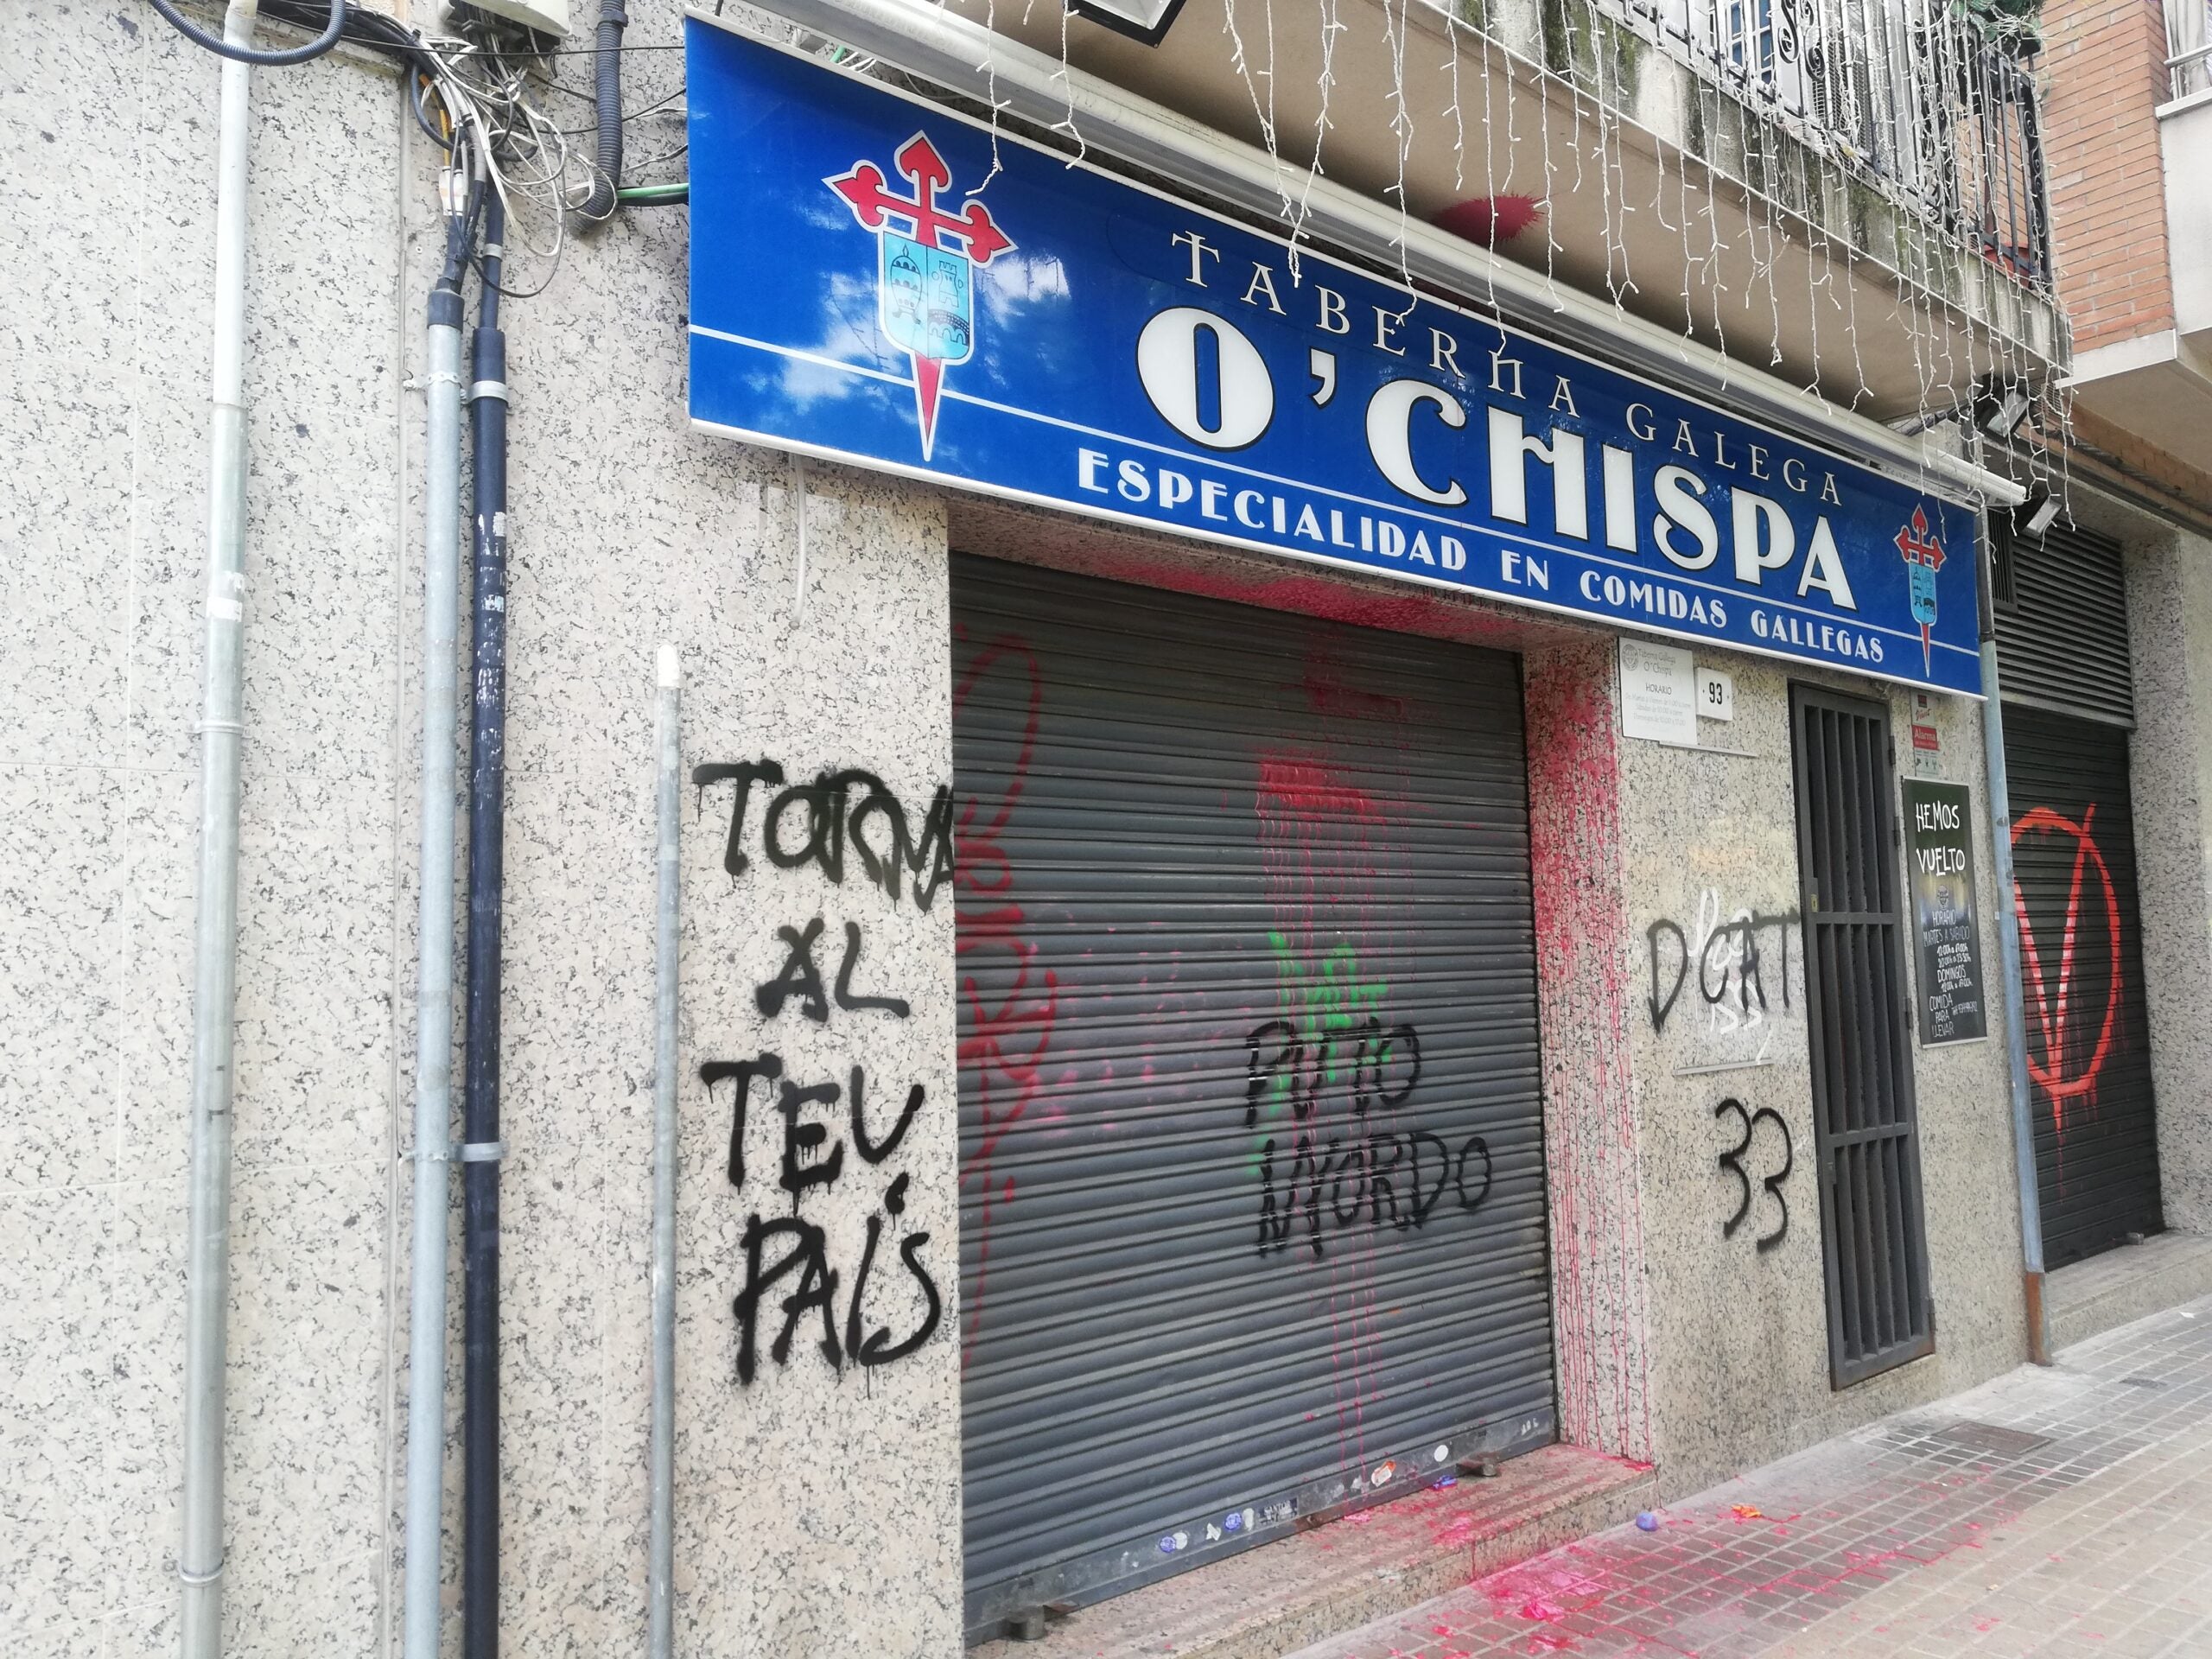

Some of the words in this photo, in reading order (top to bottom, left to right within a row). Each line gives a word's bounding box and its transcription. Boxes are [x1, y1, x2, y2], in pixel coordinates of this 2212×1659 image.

[1625, 402, 1843, 506] GALEGA
[1077, 447, 1467, 572] ESPECIALIDAD
[1501, 549, 1549, 592] EN
[1579, 569, 1727, 629] COMIDAS
[1751, 608, 1884, 664] GALLEGAS
[1645, 683, 1673, 696] HORARIO
[1708, 682, 1723, 705] 93
[1914, 728, 1936, 741] Alarma
[1915, 799, 1961, 833] HEMOS
[1915, 846, 1967, 877] VUELTO
[1932, 909, 1957, 927] HORARIO
[1923, 928, 1943, 947] MARTES
[755, 917, 911, 1023] AL
[1936, 963, 1967, 983] DOMINGOS
[1929, 993, 1954, 1012] COMIDA
[1935, 1009, 1950, 1025] PARA
[1931, 1020, 1955, 1038] LLEVAR
[699, 1053, 926, 1203] TEU
[1715, 1097, 1793, 1253] 33
[733, 1173, 944, 1384] PAÍS
